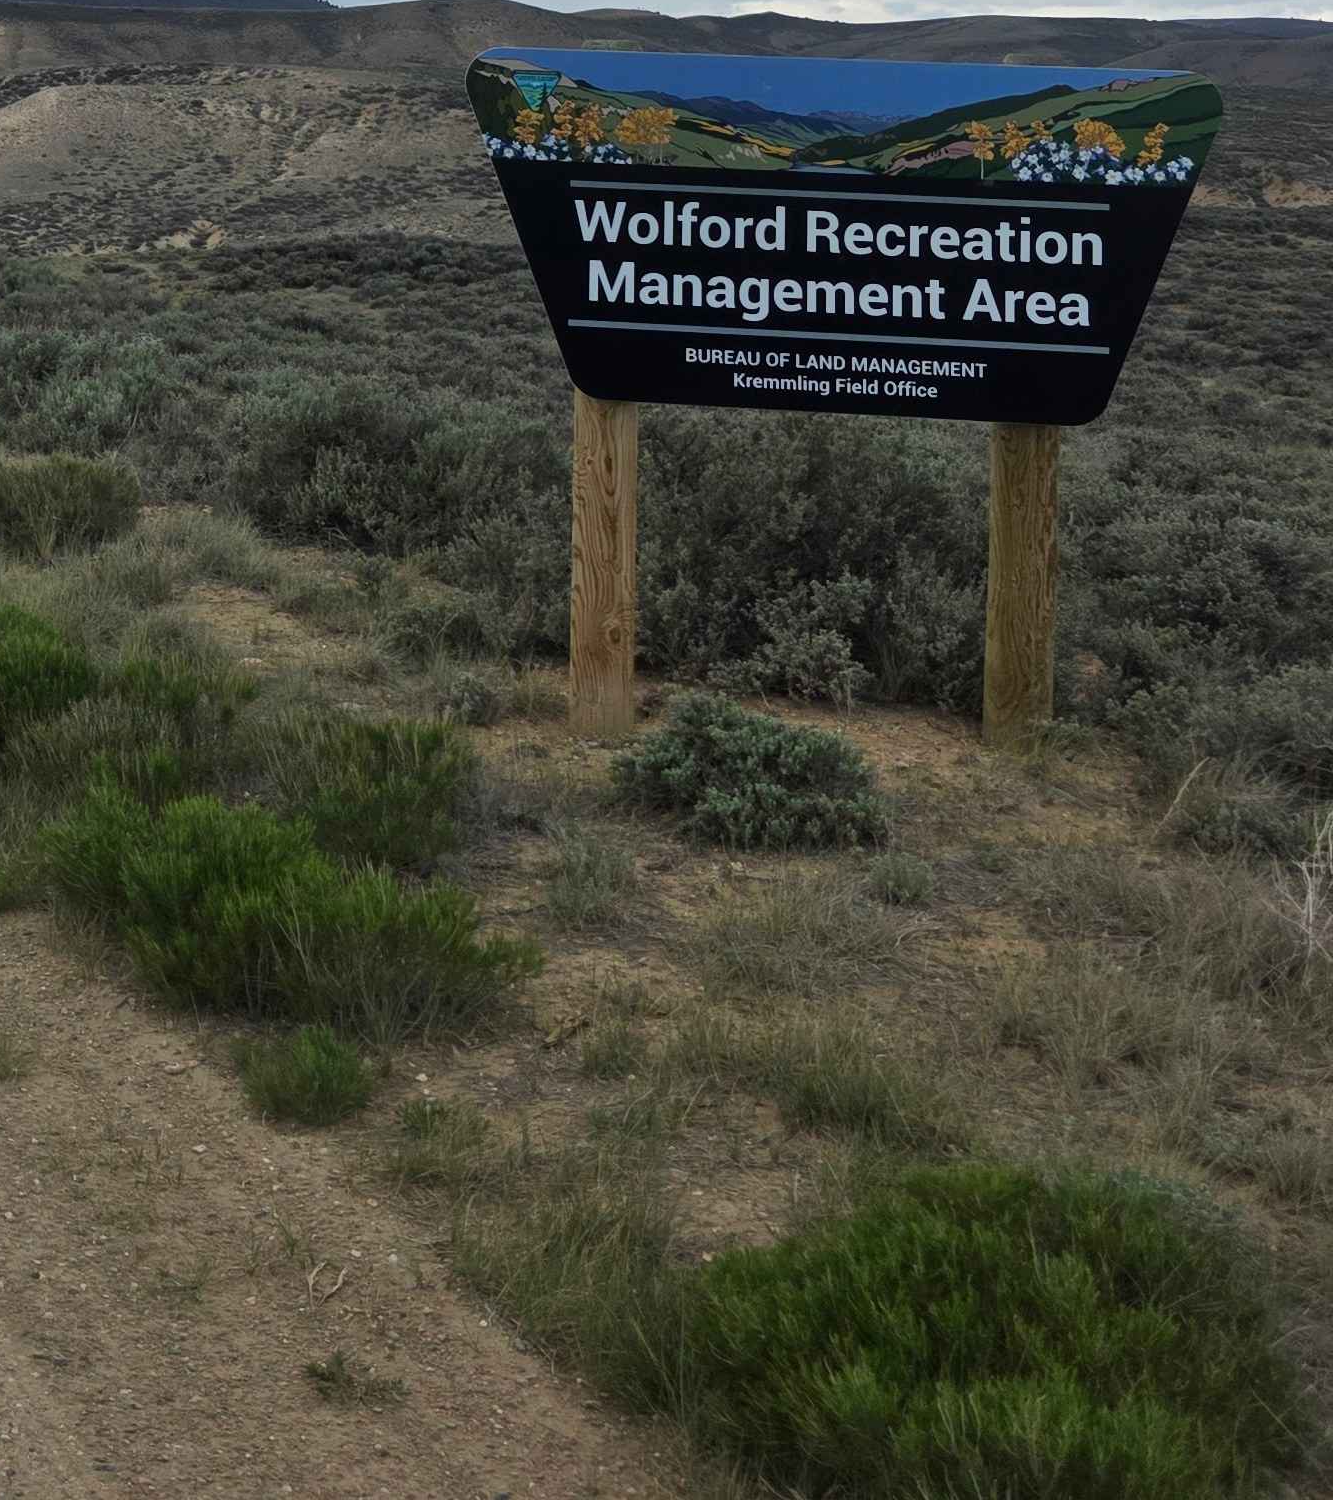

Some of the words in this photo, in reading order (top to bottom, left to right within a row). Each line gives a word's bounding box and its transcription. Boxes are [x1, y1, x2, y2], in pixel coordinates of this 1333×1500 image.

[574, 199, 786, 251] Wolford
[806, 210, 1104, 266] Recreation
[588, 259, 946, 322] Management
[962, 278, 1091, 327] Area
[685, 347, 761, 366] BUREAU
[765, 352, 791, 368] OF
[795, 353, 846, 371] LAND
[851, 356, 988, 379] MANAGEMENT
[733, 372, 830, 396] Kremmling
[835, 378, 879, 395] Field
[883, 380, 938, 398] Office
